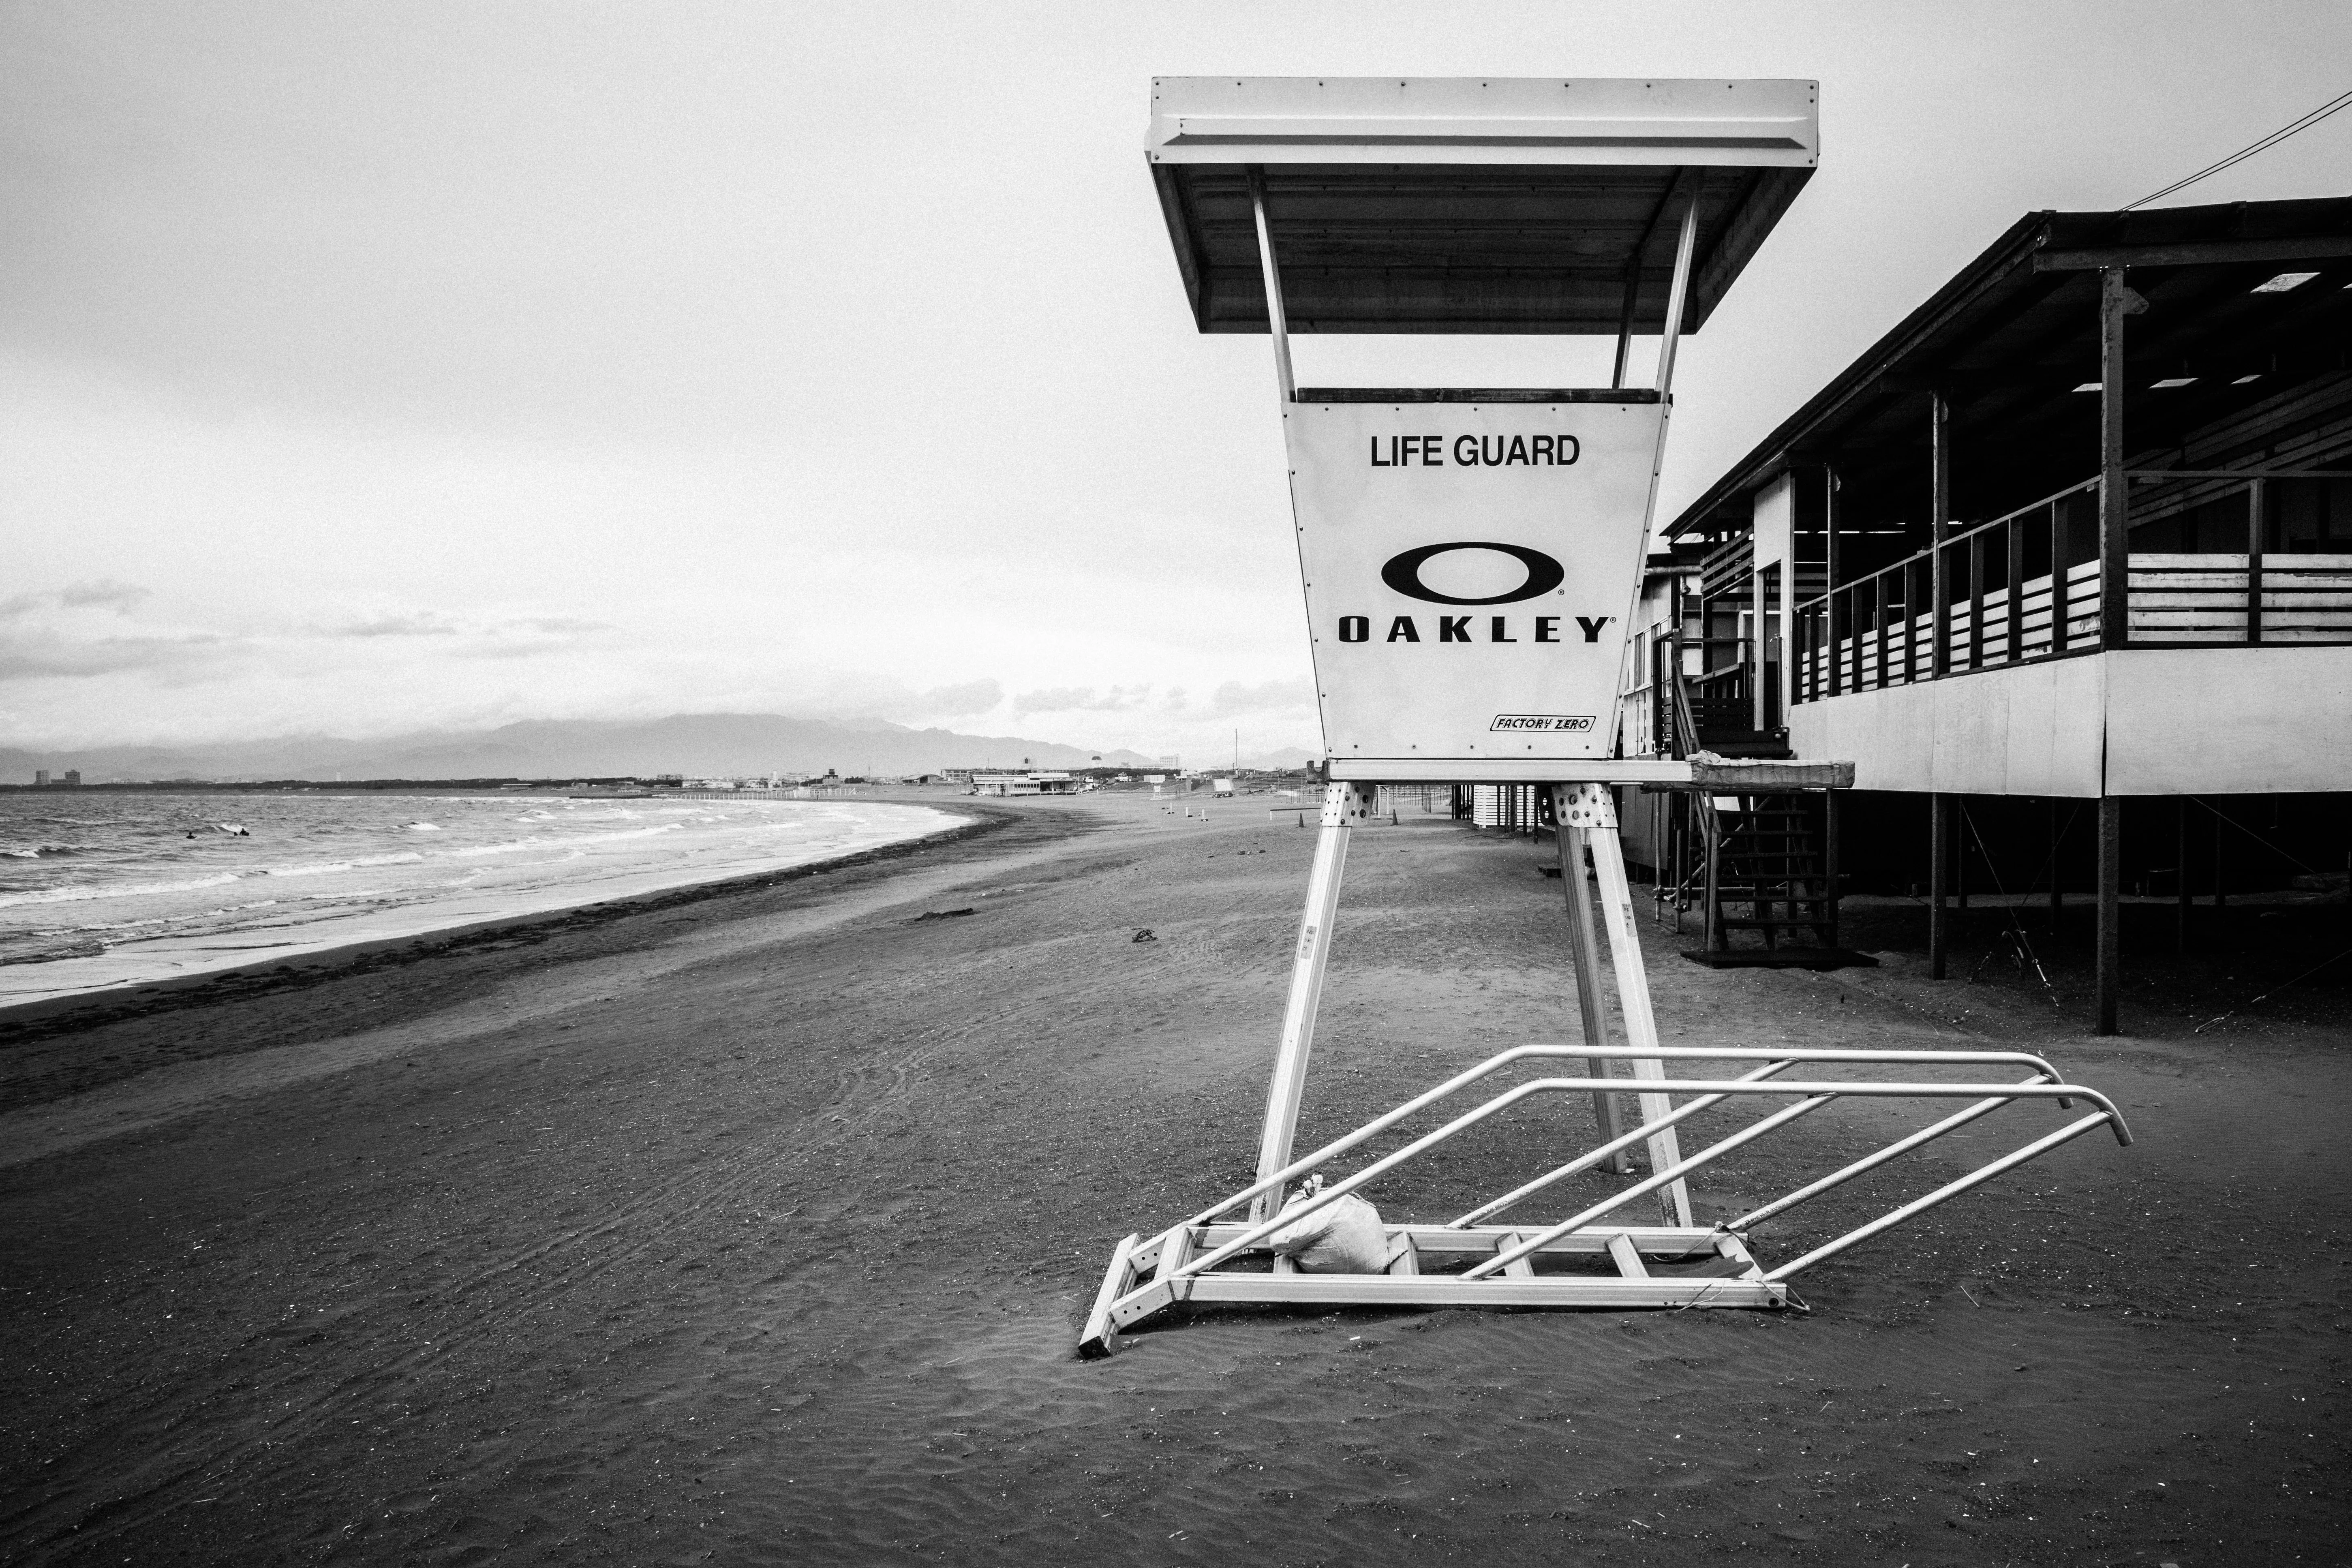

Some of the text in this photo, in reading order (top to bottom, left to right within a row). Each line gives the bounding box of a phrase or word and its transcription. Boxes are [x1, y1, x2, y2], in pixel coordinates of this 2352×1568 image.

[1371, 434, 1580, 466] LIFE GUARD
[1496, 718, 1590, 729] FACTORY ZERO
